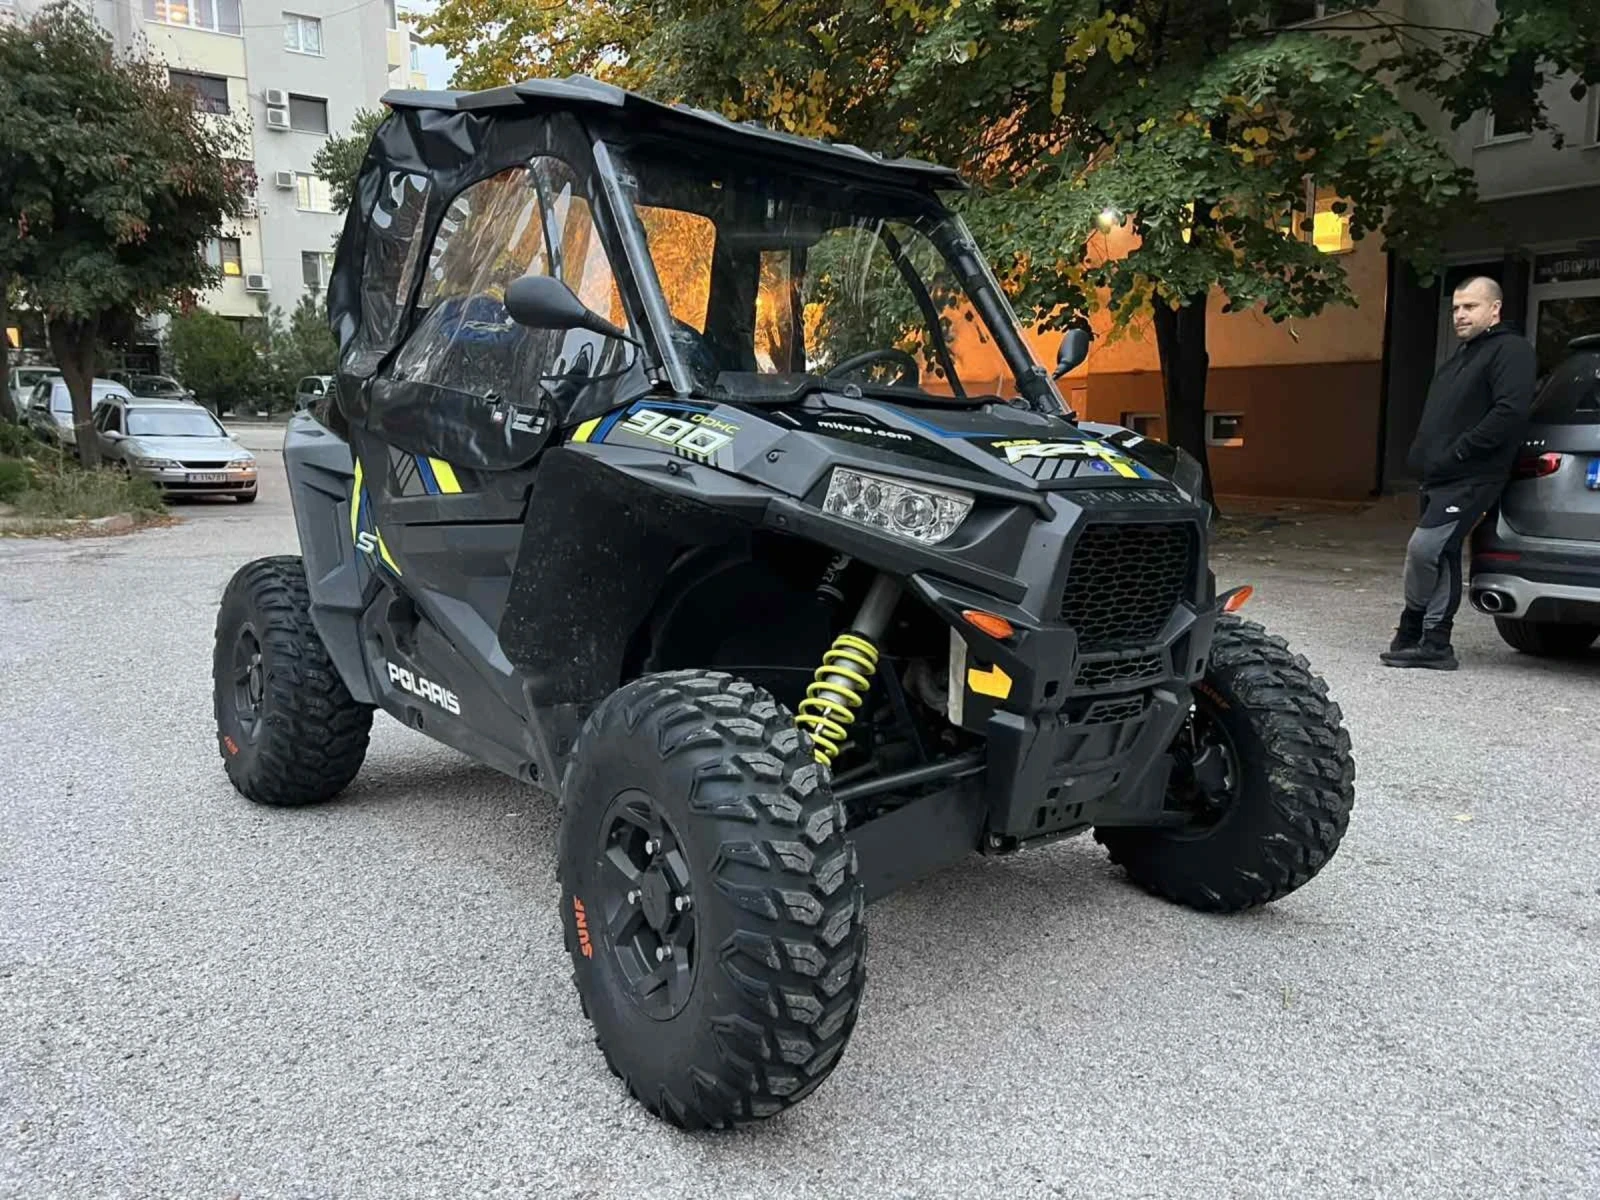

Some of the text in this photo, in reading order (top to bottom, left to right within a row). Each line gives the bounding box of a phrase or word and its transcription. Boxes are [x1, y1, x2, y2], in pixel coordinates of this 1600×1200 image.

[620, 409, 735, 456] 900
[690, 414, 740, 434] DOHC
[356, 531, 378, 553] S
[387, 661, 461, 715] POLARIS
[573, 895, 593, 960] SUNF
